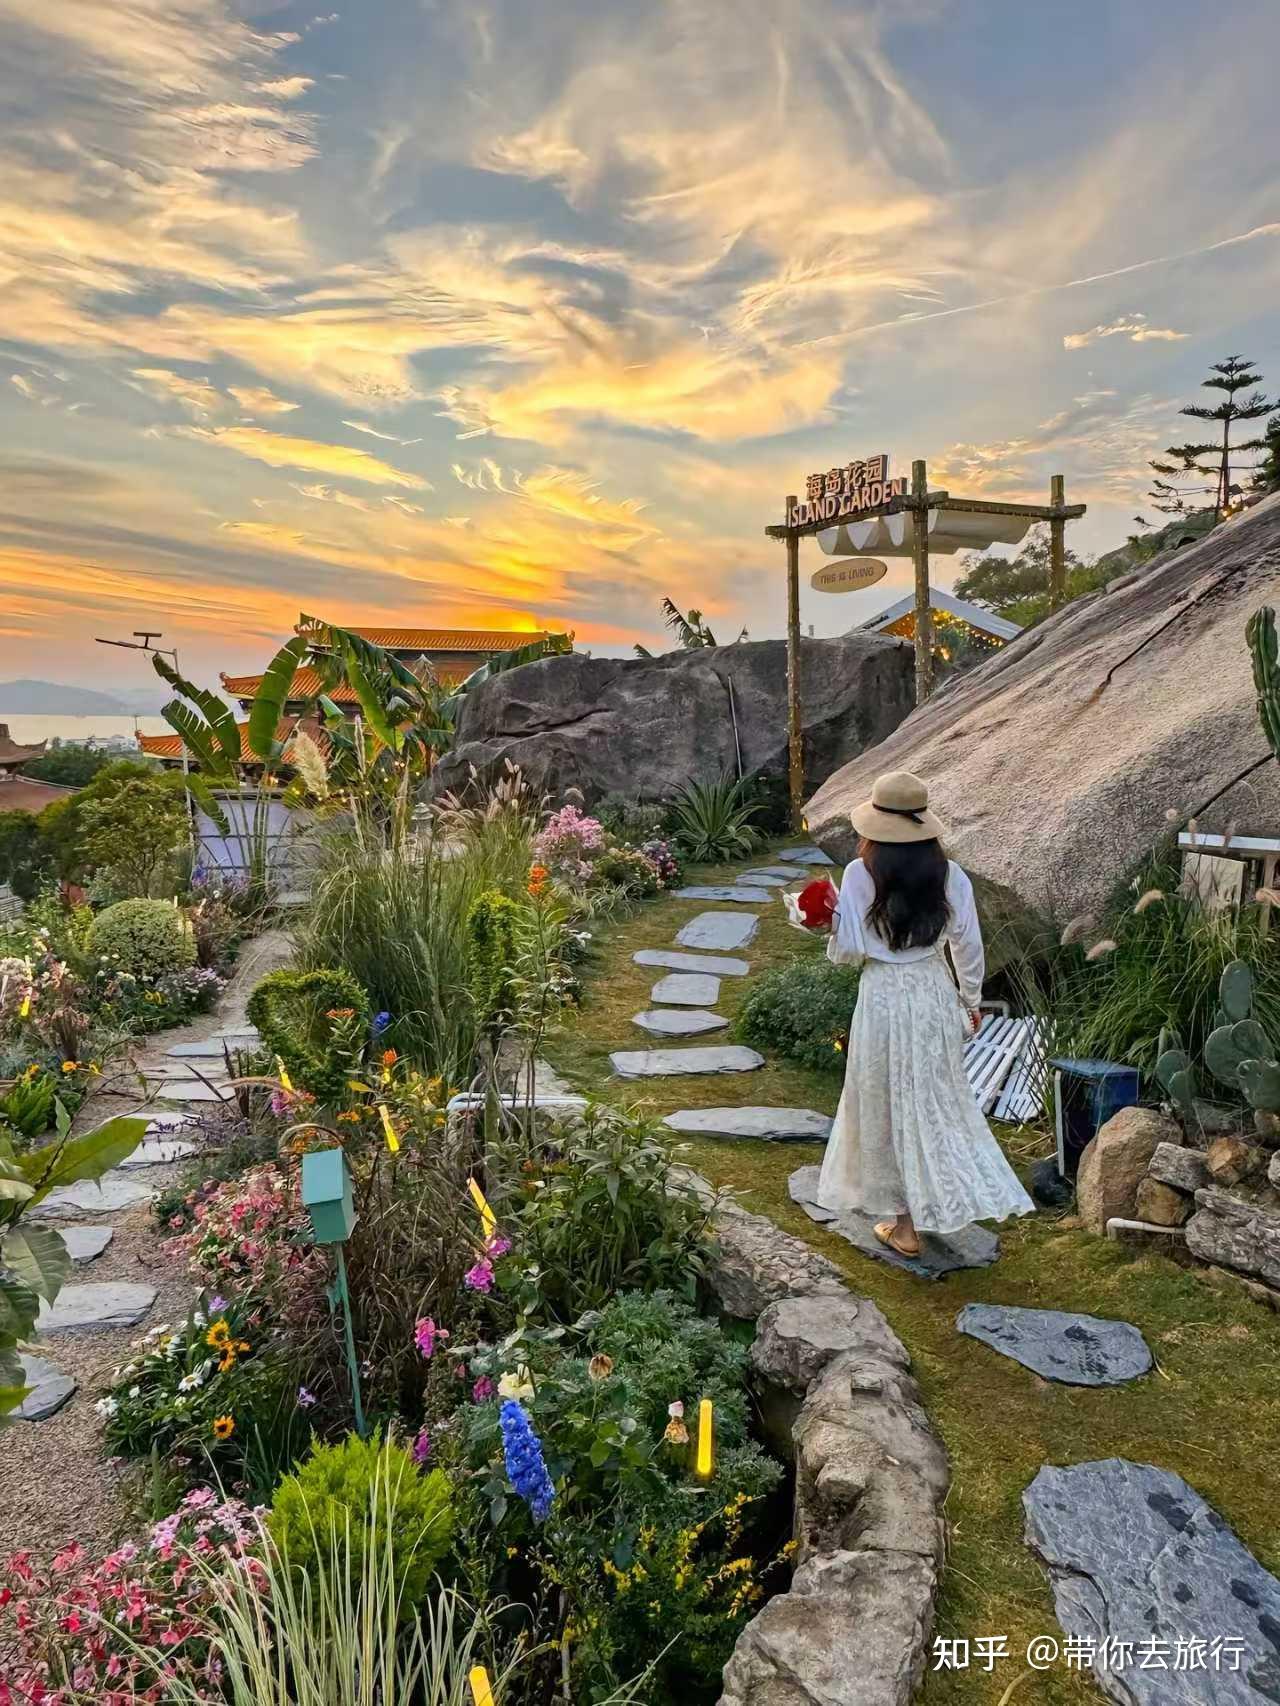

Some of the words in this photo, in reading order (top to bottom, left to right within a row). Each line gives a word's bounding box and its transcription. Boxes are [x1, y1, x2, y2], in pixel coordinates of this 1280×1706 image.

[805, 455, 884, 501] 海岛花园
[787, 496, 837, 528] ISLAND
[838, 479, 903, 515] GARDEN
